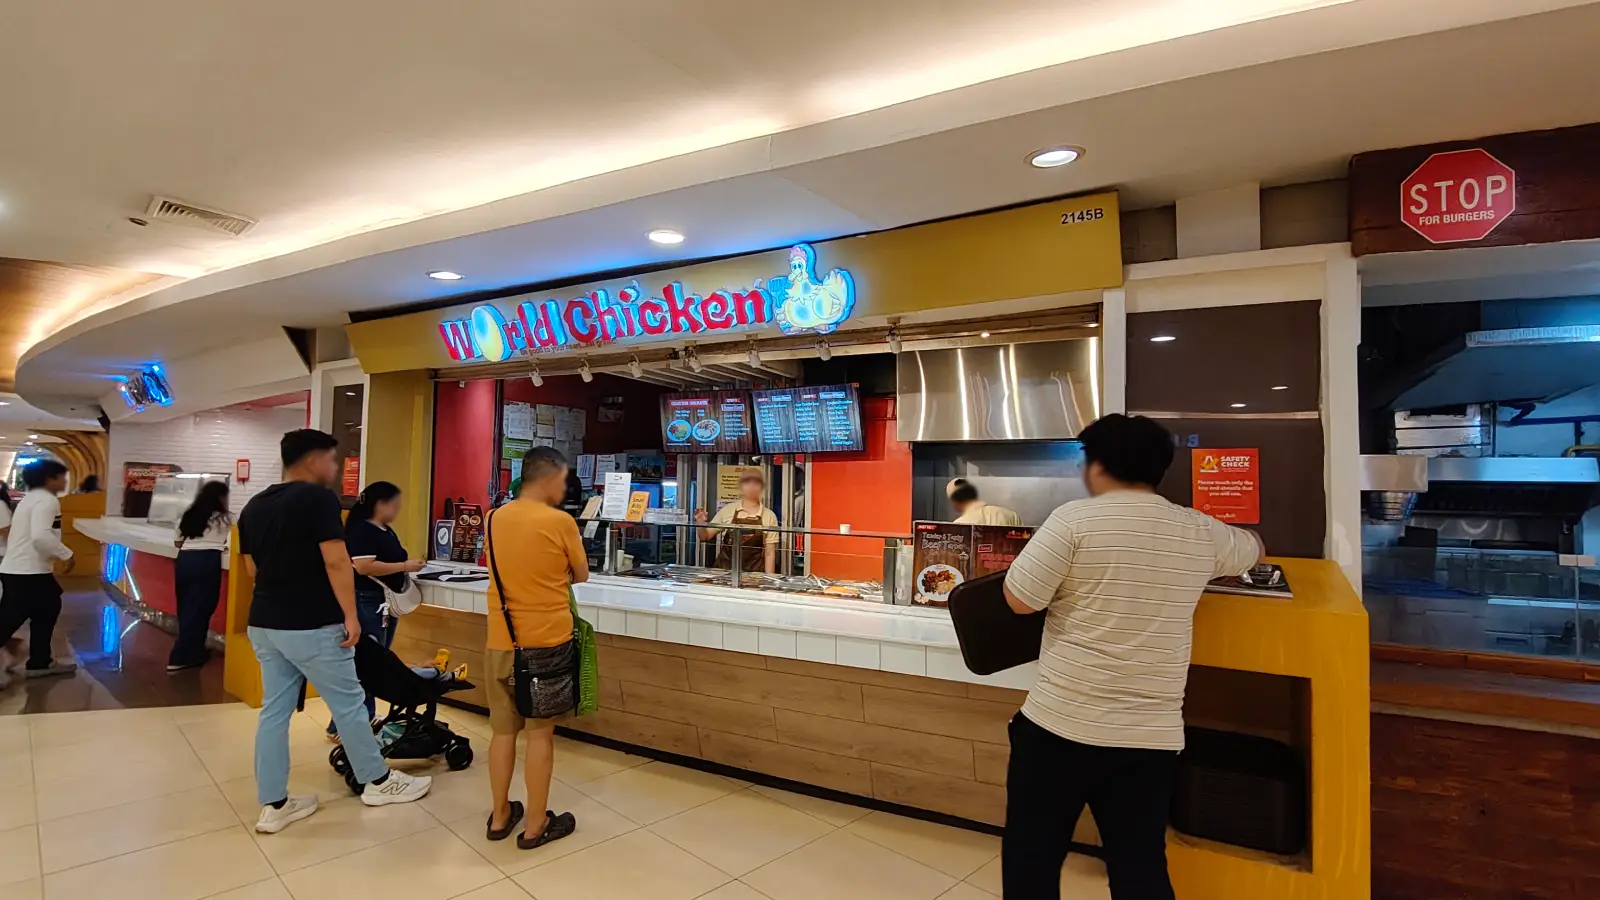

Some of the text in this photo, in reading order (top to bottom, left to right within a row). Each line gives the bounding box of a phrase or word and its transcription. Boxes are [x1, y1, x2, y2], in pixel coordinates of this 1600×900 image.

[1410, 175, 1507, 214] STOP
[1061, 208, 1104, 225] 2145B
[1419, 210, 1496, 226] FOR BURGERS
[563, 280, 774, 342] Chicken
[922, 539, 941, 550] Beef
[947, 534, 964, 543] Tasty
